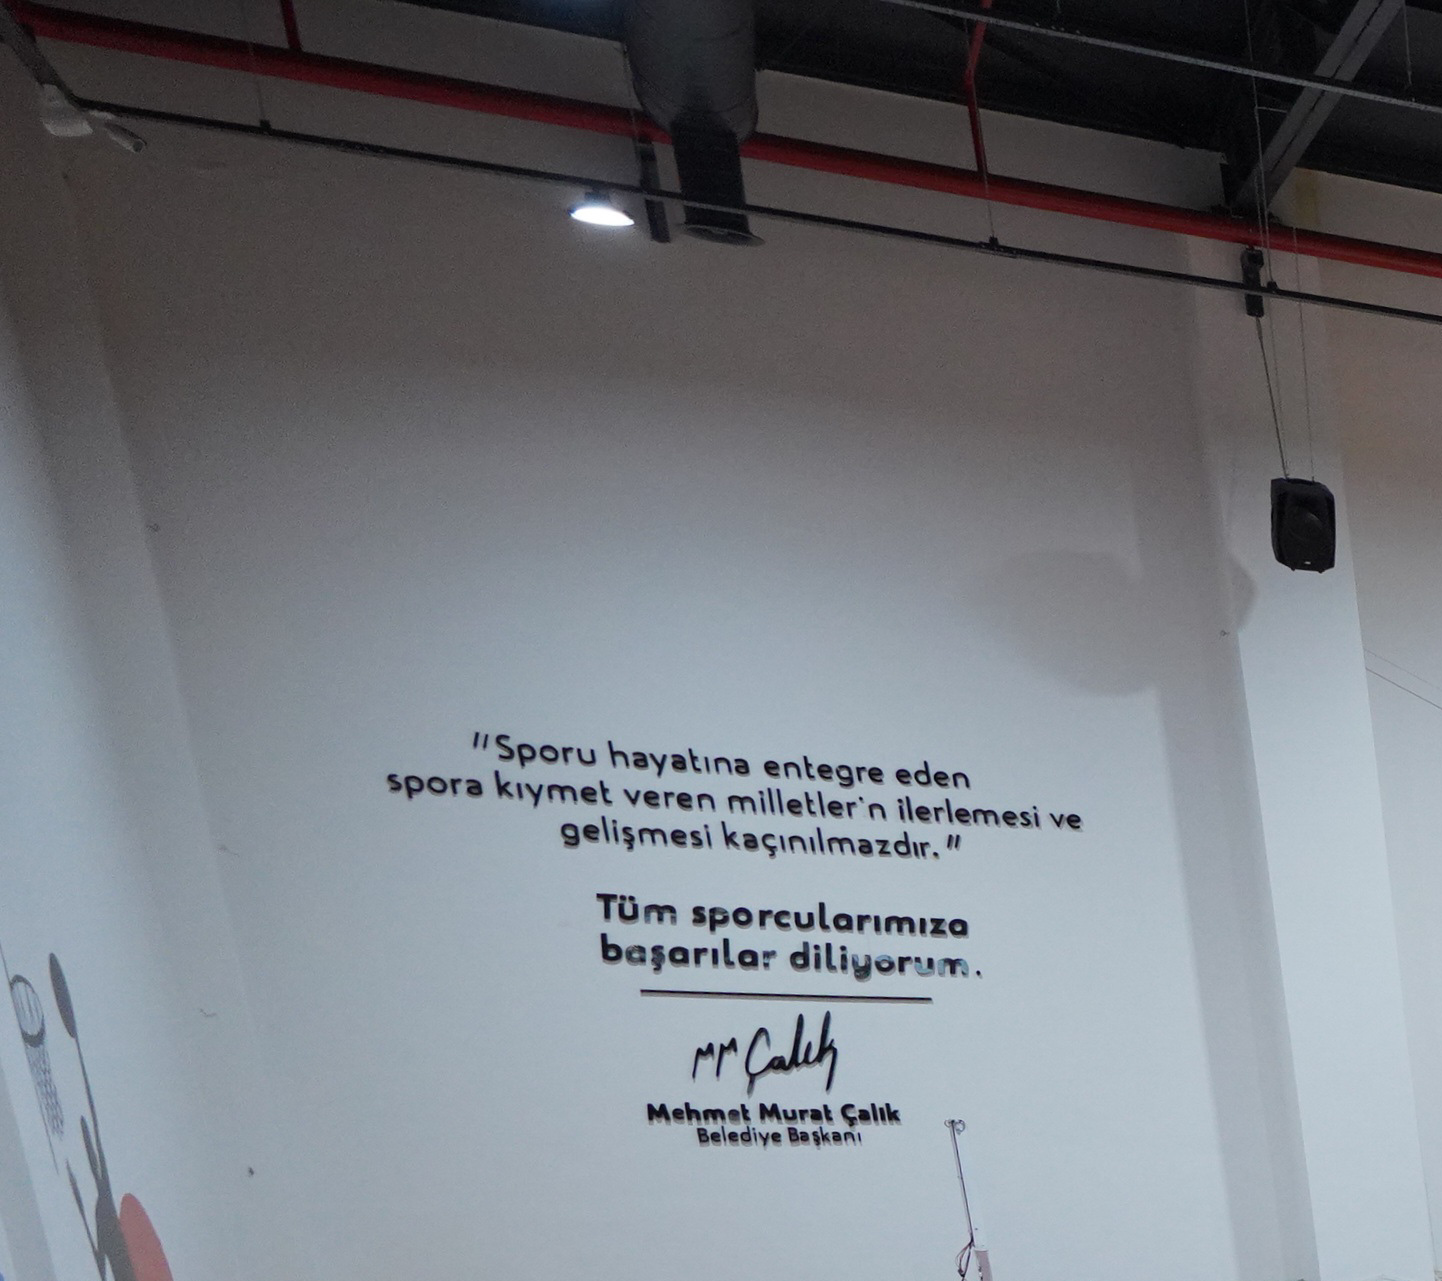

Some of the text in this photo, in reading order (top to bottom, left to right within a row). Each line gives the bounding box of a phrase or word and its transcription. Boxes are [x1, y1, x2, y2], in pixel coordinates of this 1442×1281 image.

[608, 741, 751, 777] hayatına
[764, 756, 884, 787] entegre
[895, 761, 970, 790] eden
[387, 771, 1082, 831] spora kıymet veren ilerlemesi ve
[561, 817, 712, 851] gelişmesi
[596, 892, 970, 938] Tüm sporcularımıza
[599, 933, 983, 981] başarılar diliyorum.
[646, 1103, 901, 1126] Mehmet Murat Çalık
[697, 1126, 863, 1150] Belediye Başkanı
